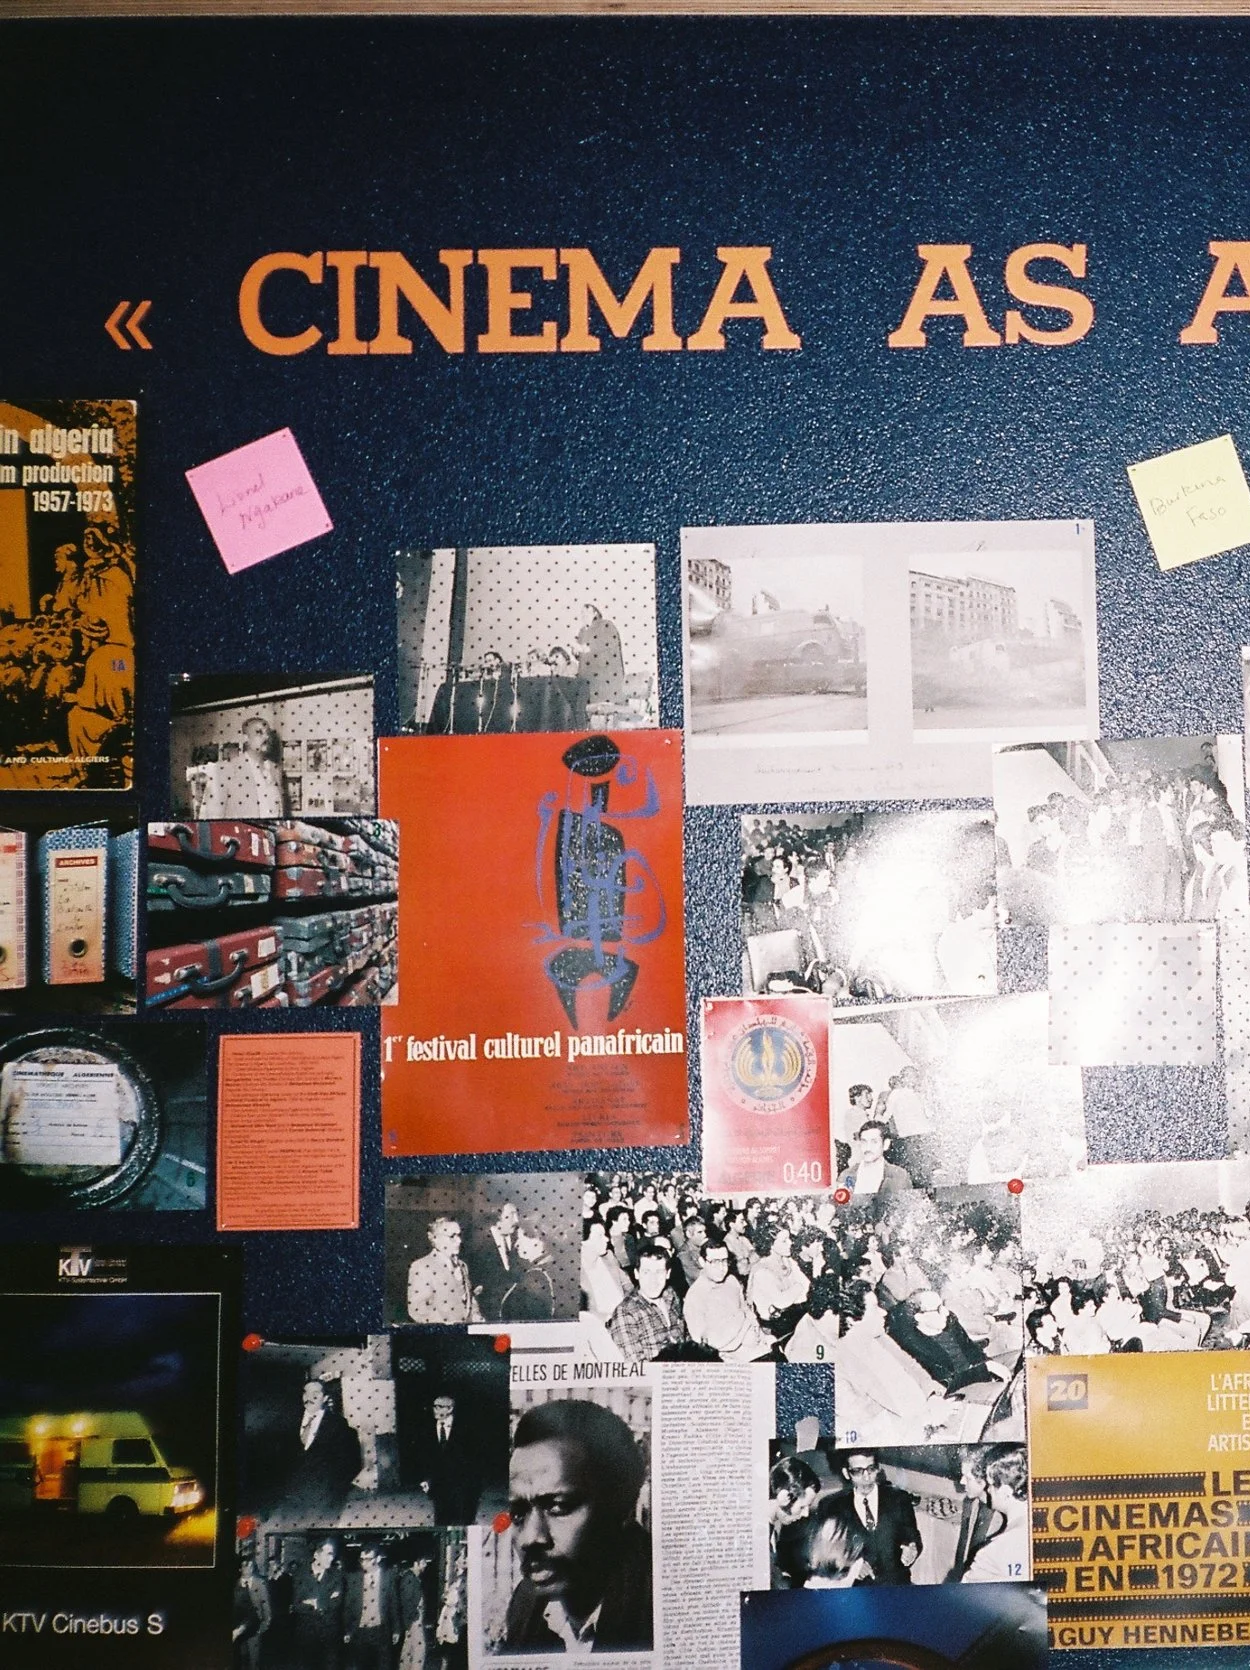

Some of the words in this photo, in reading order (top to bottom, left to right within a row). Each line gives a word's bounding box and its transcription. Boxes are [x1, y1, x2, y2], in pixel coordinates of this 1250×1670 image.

[239, 246, 801, 355] CINEMA
[888, 242, 1095, 348] AS
[29, 423, 114, 459] algeria
[22, 462, 113, 486] production
[33, 491, 113, 512] 1957-1973
[1149, 476, 1226, 516] Burkina
[1186, 505, 1227, 527] Faso
[60, 859, 95, 867] ARCHIVES
[406, 1033, 477, 1062] festival
[484, 1031, 561, 1060] culturel
[567, 1027, 684, 1063] panafricain
[815, 1345, 824, 1360] 9
[553, 1364, 567, 1381] DE
[573, 1361, 647, 1380] MONTREAL
[1049, 1380, 1087, 1401] 20
[1053, 1499, 1235, 1532] CINEMAS
[1007, 1564, 1023, 1577] 12
[1075, 1565, 1123, 1592] EN
[1161, 1563, 1238, 1589] 1972
[2, 1612, 46, 1633] KTV
[52, 1613, 139, 1634] Cinebus
[147, 1614, 164, 1635] S
[1058, 1627, 1114, 1647] GUY
